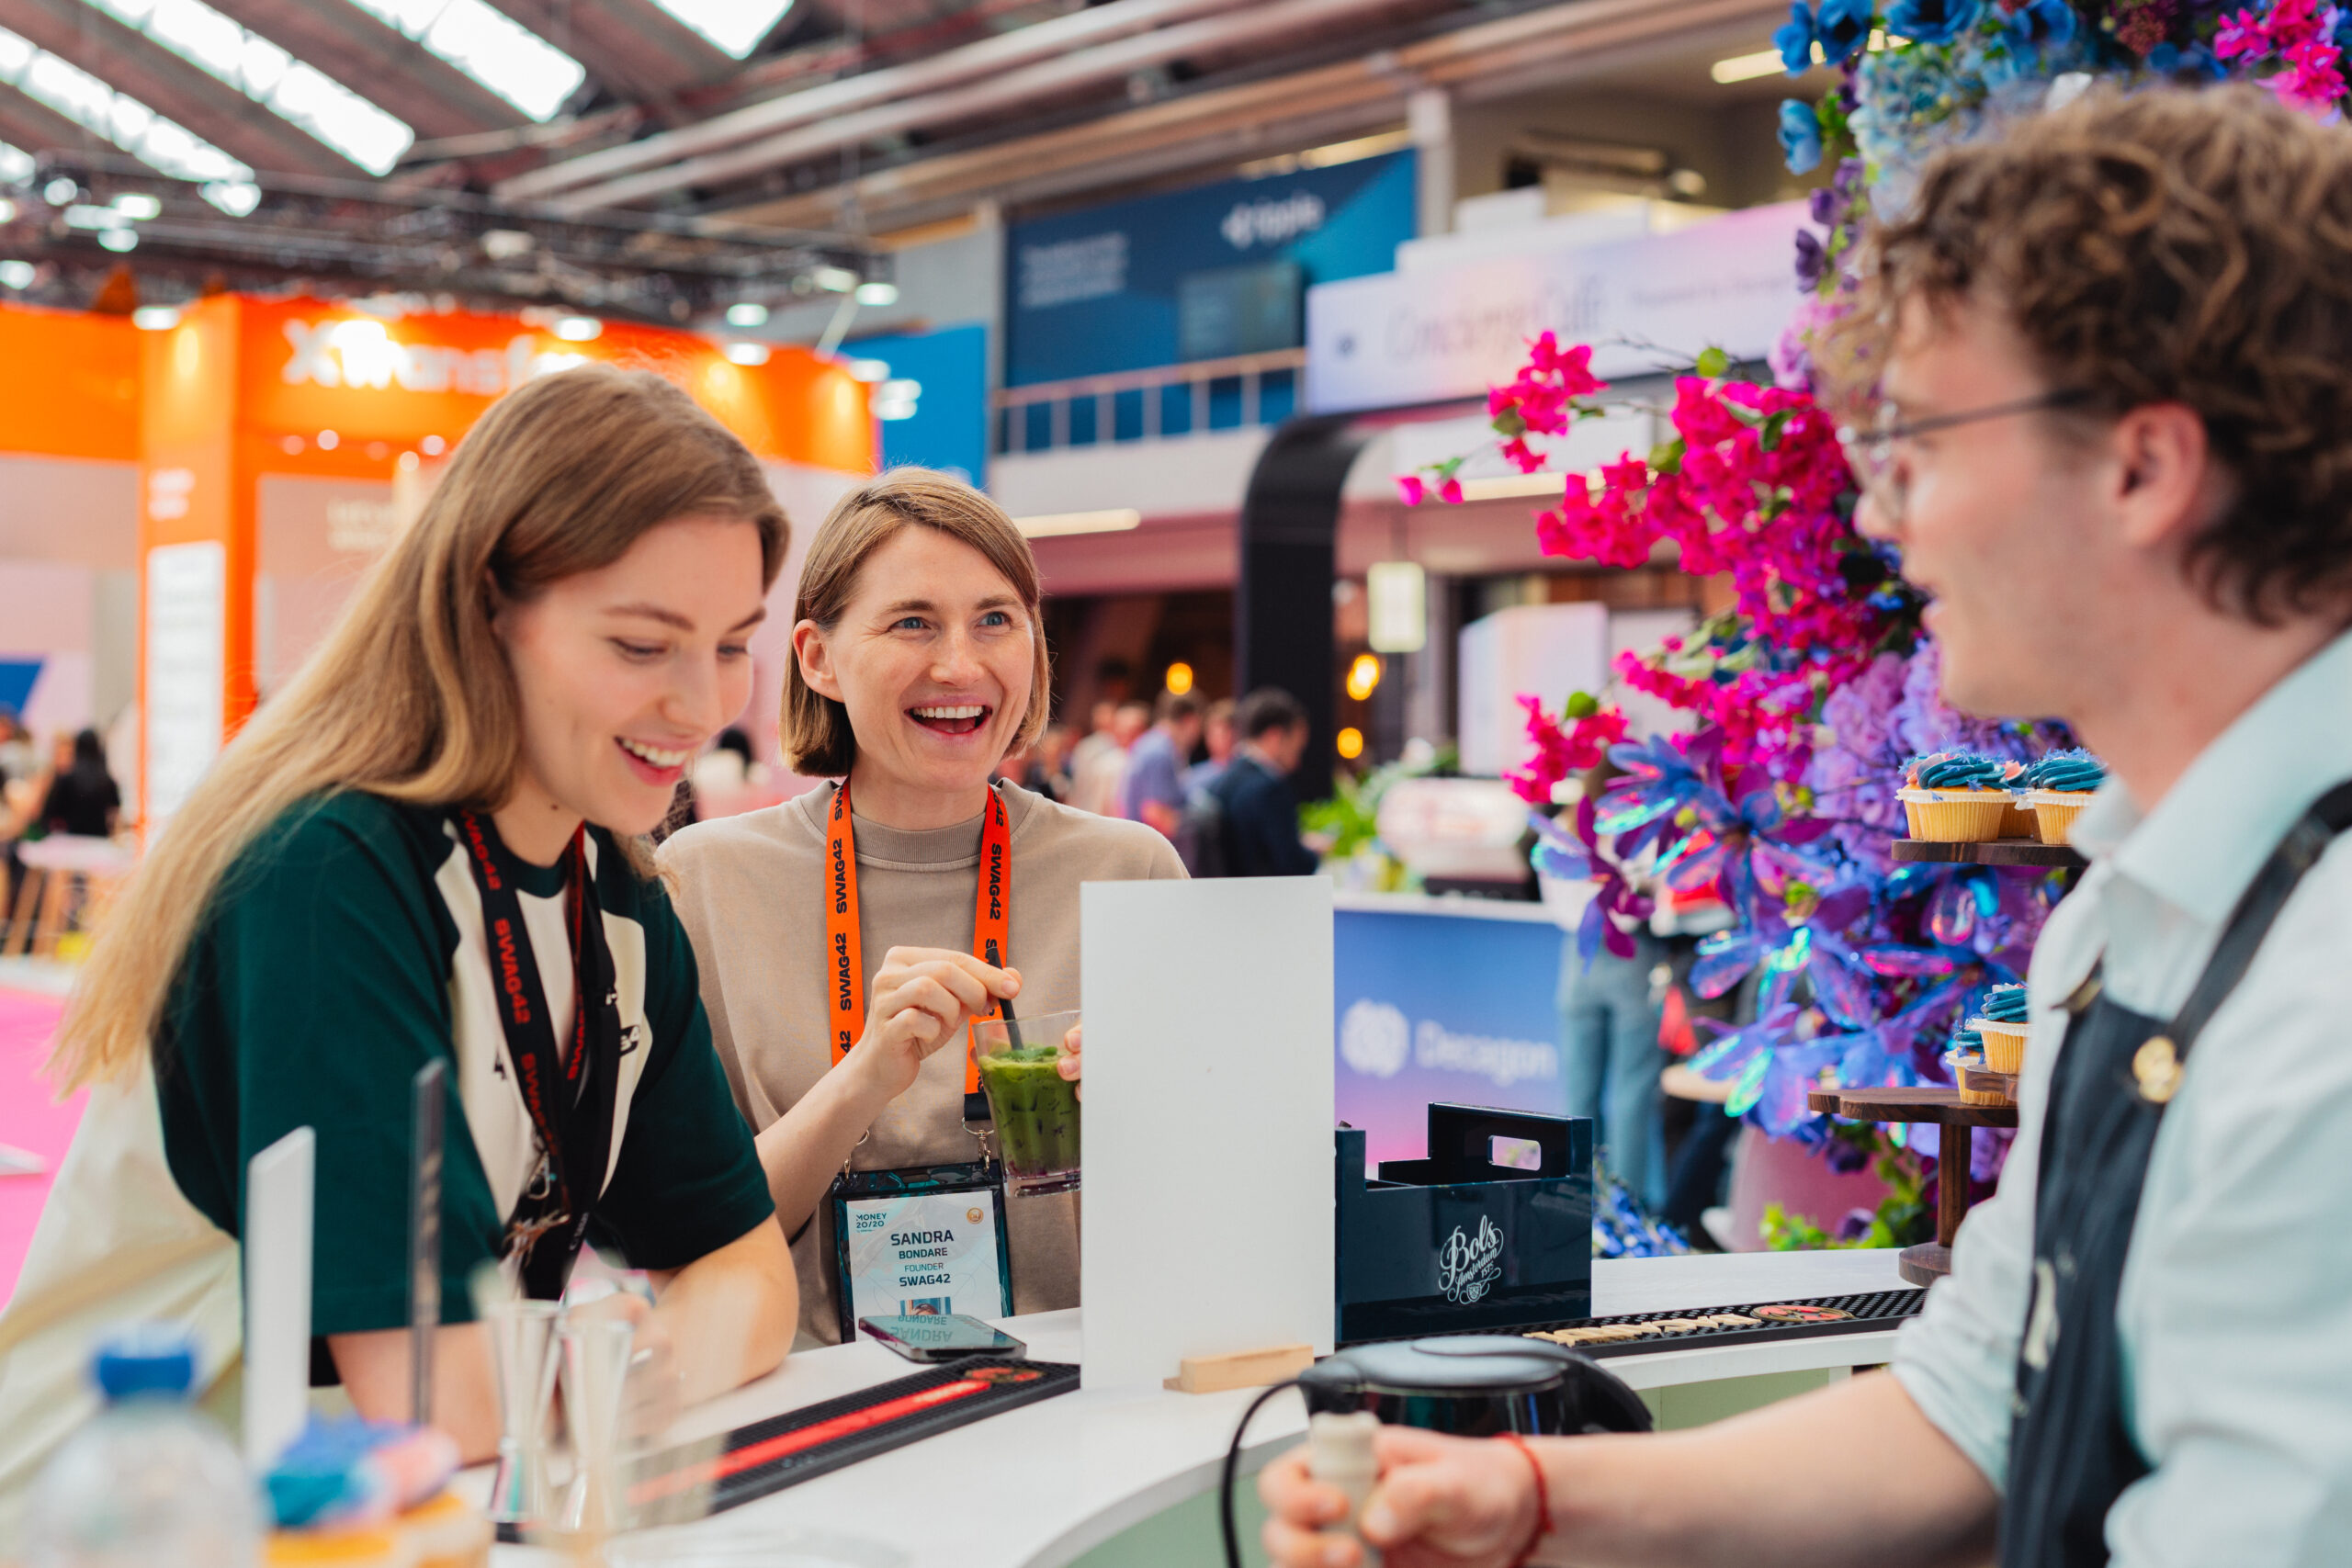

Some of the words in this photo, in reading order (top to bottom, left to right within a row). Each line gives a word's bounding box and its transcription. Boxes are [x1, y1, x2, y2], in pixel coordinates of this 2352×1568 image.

[462, 810, 502, 890] WAG42
[833, 838, 847, 914] SWAG42
[989, 843, 1001, 920] SWAG42
[494, 918, 531, 1024] SWAG42
[835, 932, 852, 1011] SWAG42
[855, 1213, 888, 1222] MONEY
[855, 1220, 885, 1229] 20/20
[890, 1229, 955, 1247] SANDRA
[899, 1247, 948, 1259] BONDARE
[904, 1262, 944, 1272] FOUNDER
[1440, 1214, 1501, 1291] Bols
[1453, 1247, 1498, 1292] Amsterdam
[899, 1273, 952, 1287] SWAG42
